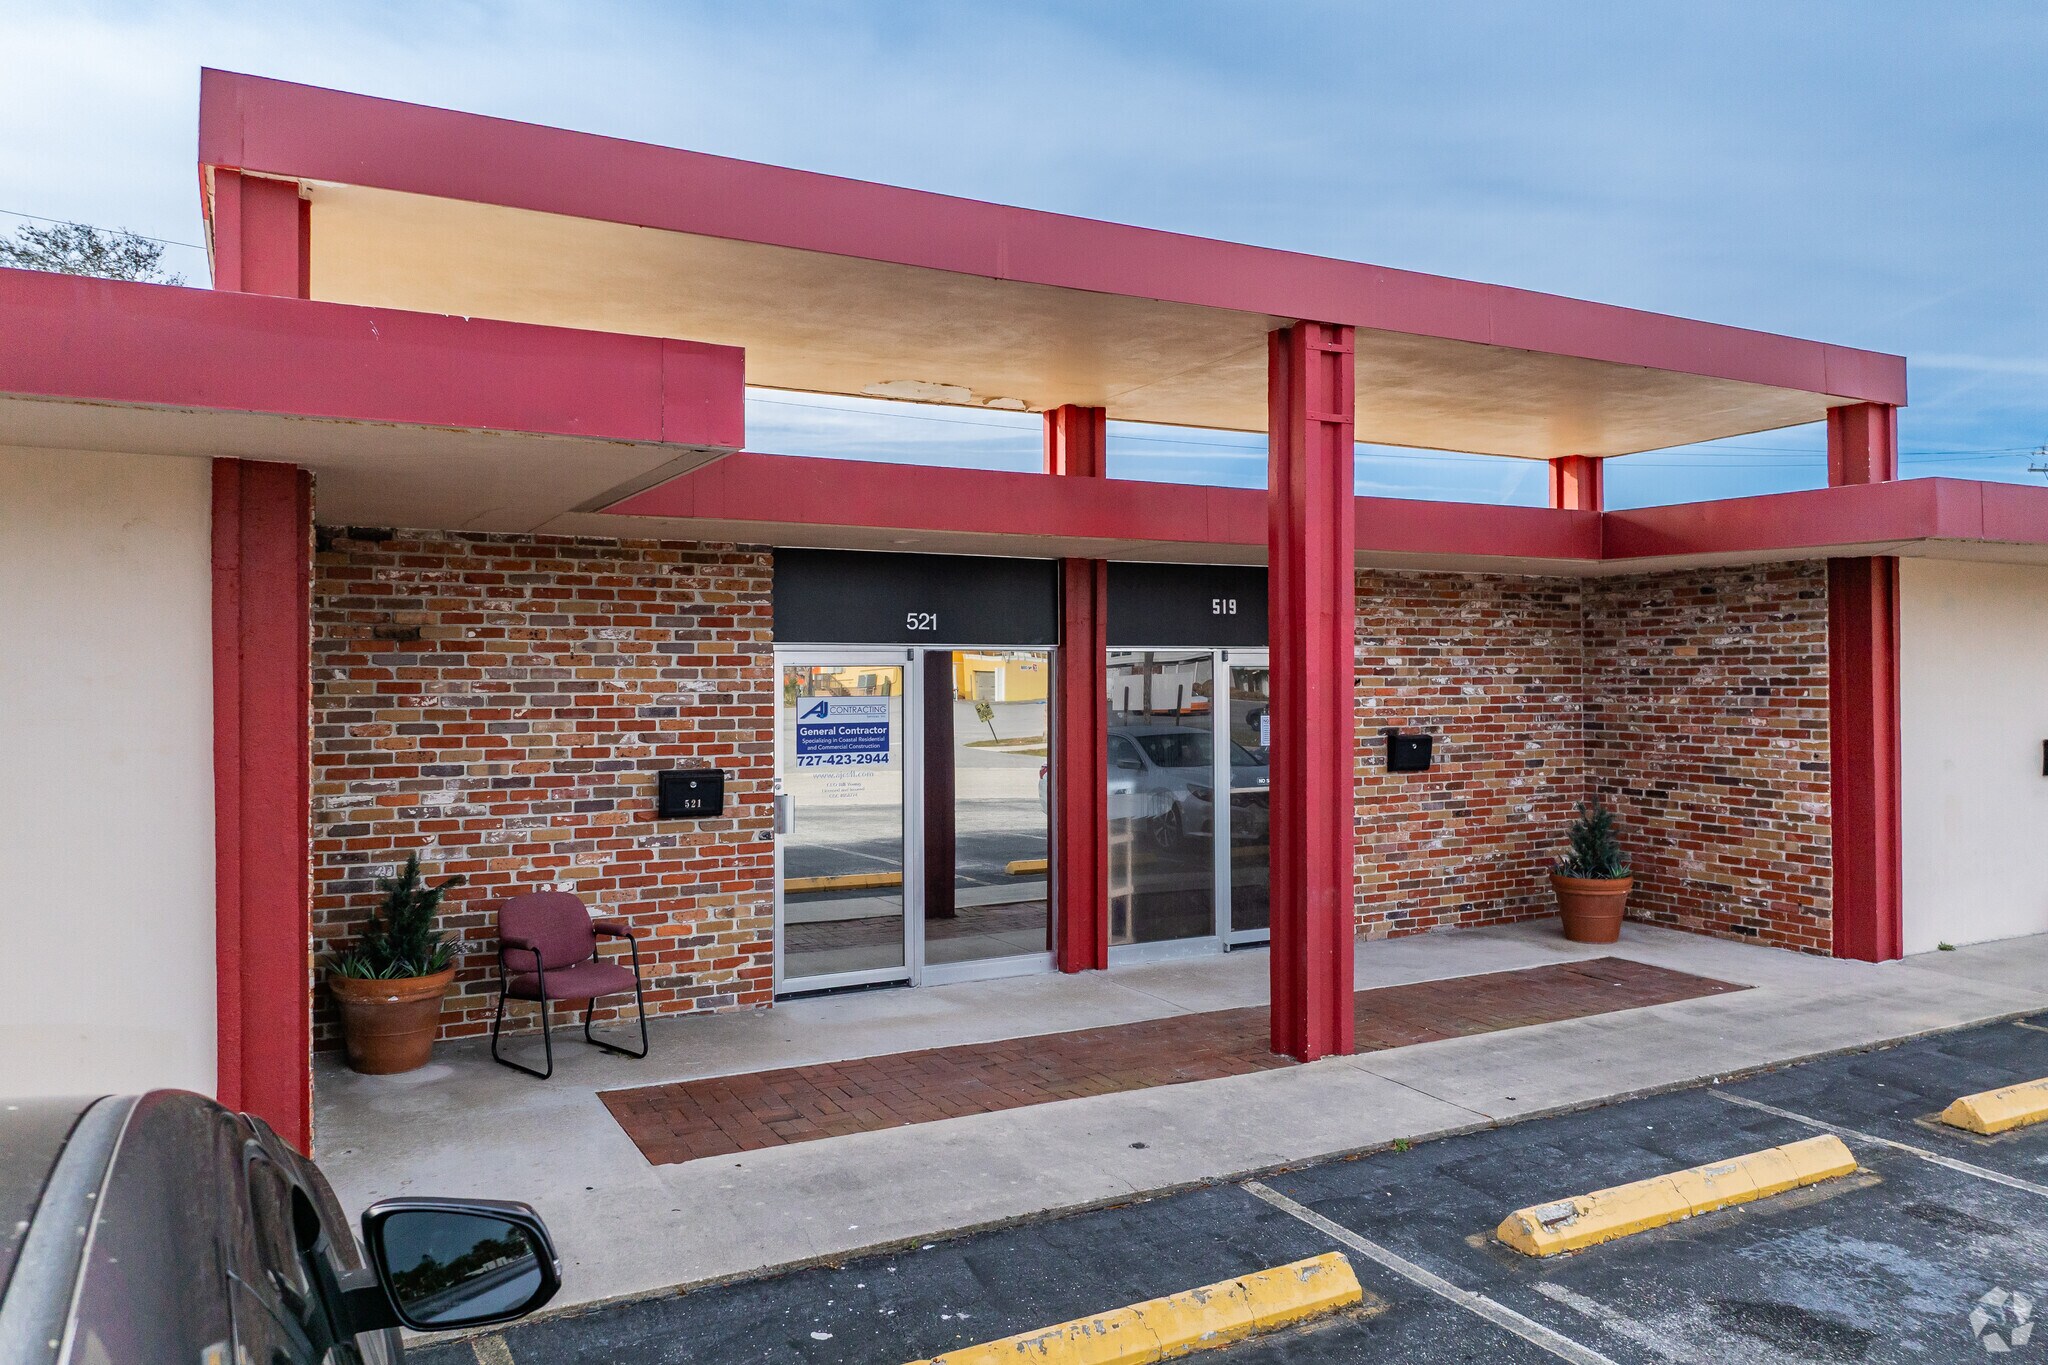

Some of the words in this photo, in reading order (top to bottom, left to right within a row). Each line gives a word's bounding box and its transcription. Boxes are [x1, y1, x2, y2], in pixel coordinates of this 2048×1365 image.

[1212, 598, 1237, 615] 519
[906, 612, 937, 630] 521
[800, 700, 828, 719] AJ
[830, 705, 886, 714] CONTRACTING
[800, 726, 836, 736] General
[838, 726, 887, 735] Contractor
[802, 737, 832, 745] Specializing
[797, 753, 889, 767] 727-423-2944
[684, 799, 701, 808] 521
